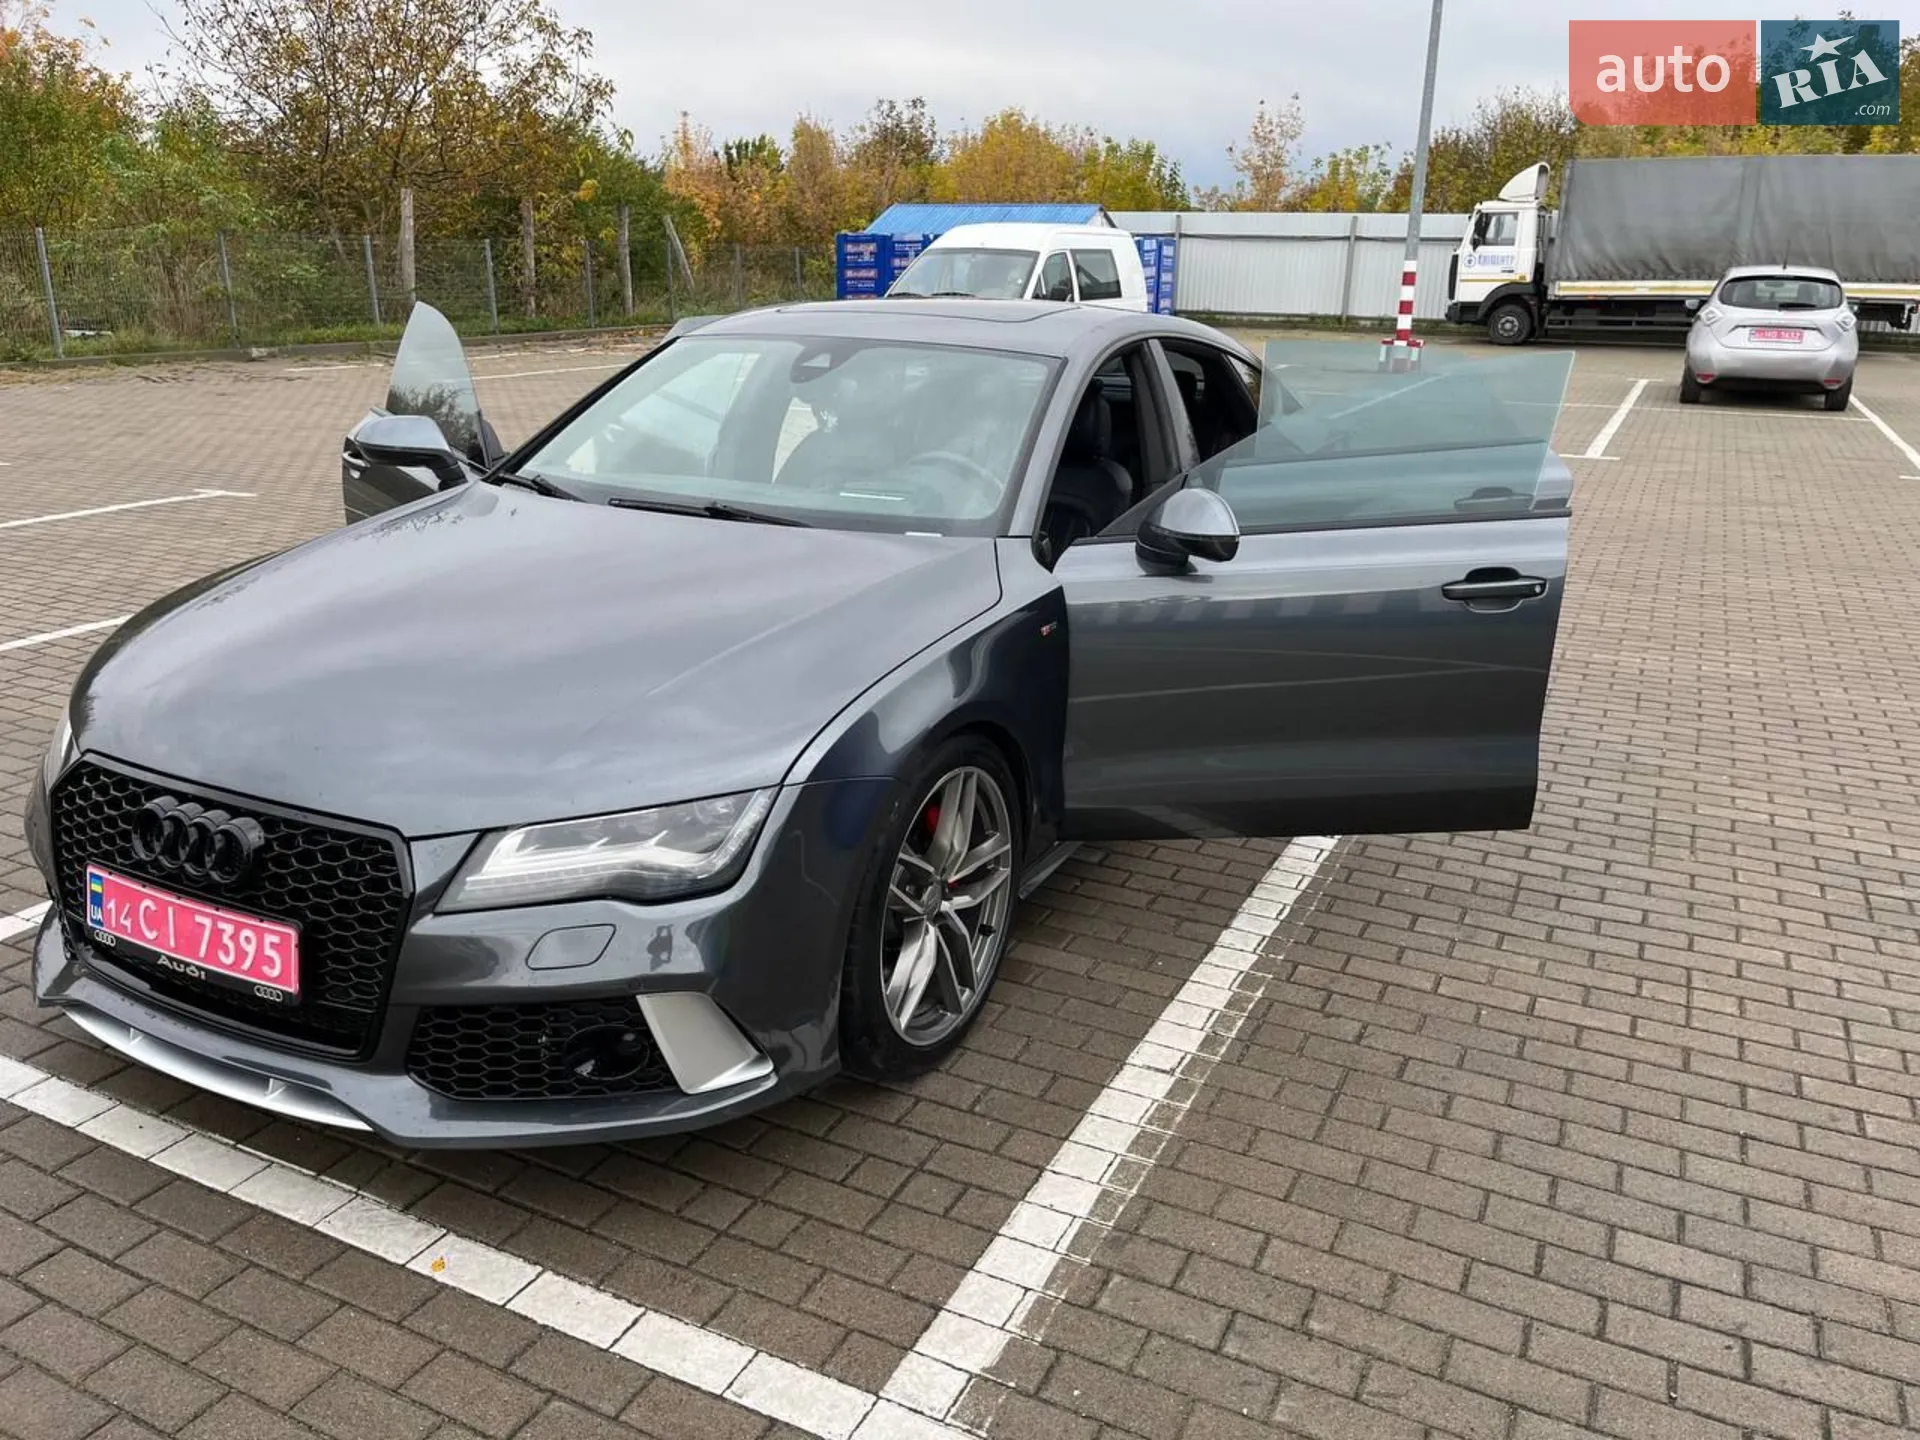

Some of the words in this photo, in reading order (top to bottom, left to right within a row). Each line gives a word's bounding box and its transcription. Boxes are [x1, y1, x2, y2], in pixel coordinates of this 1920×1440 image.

[91, 904, 103, 921] UA
[194, 915, 282, 979] 7395
[157, 954, 207, 981] Audi
